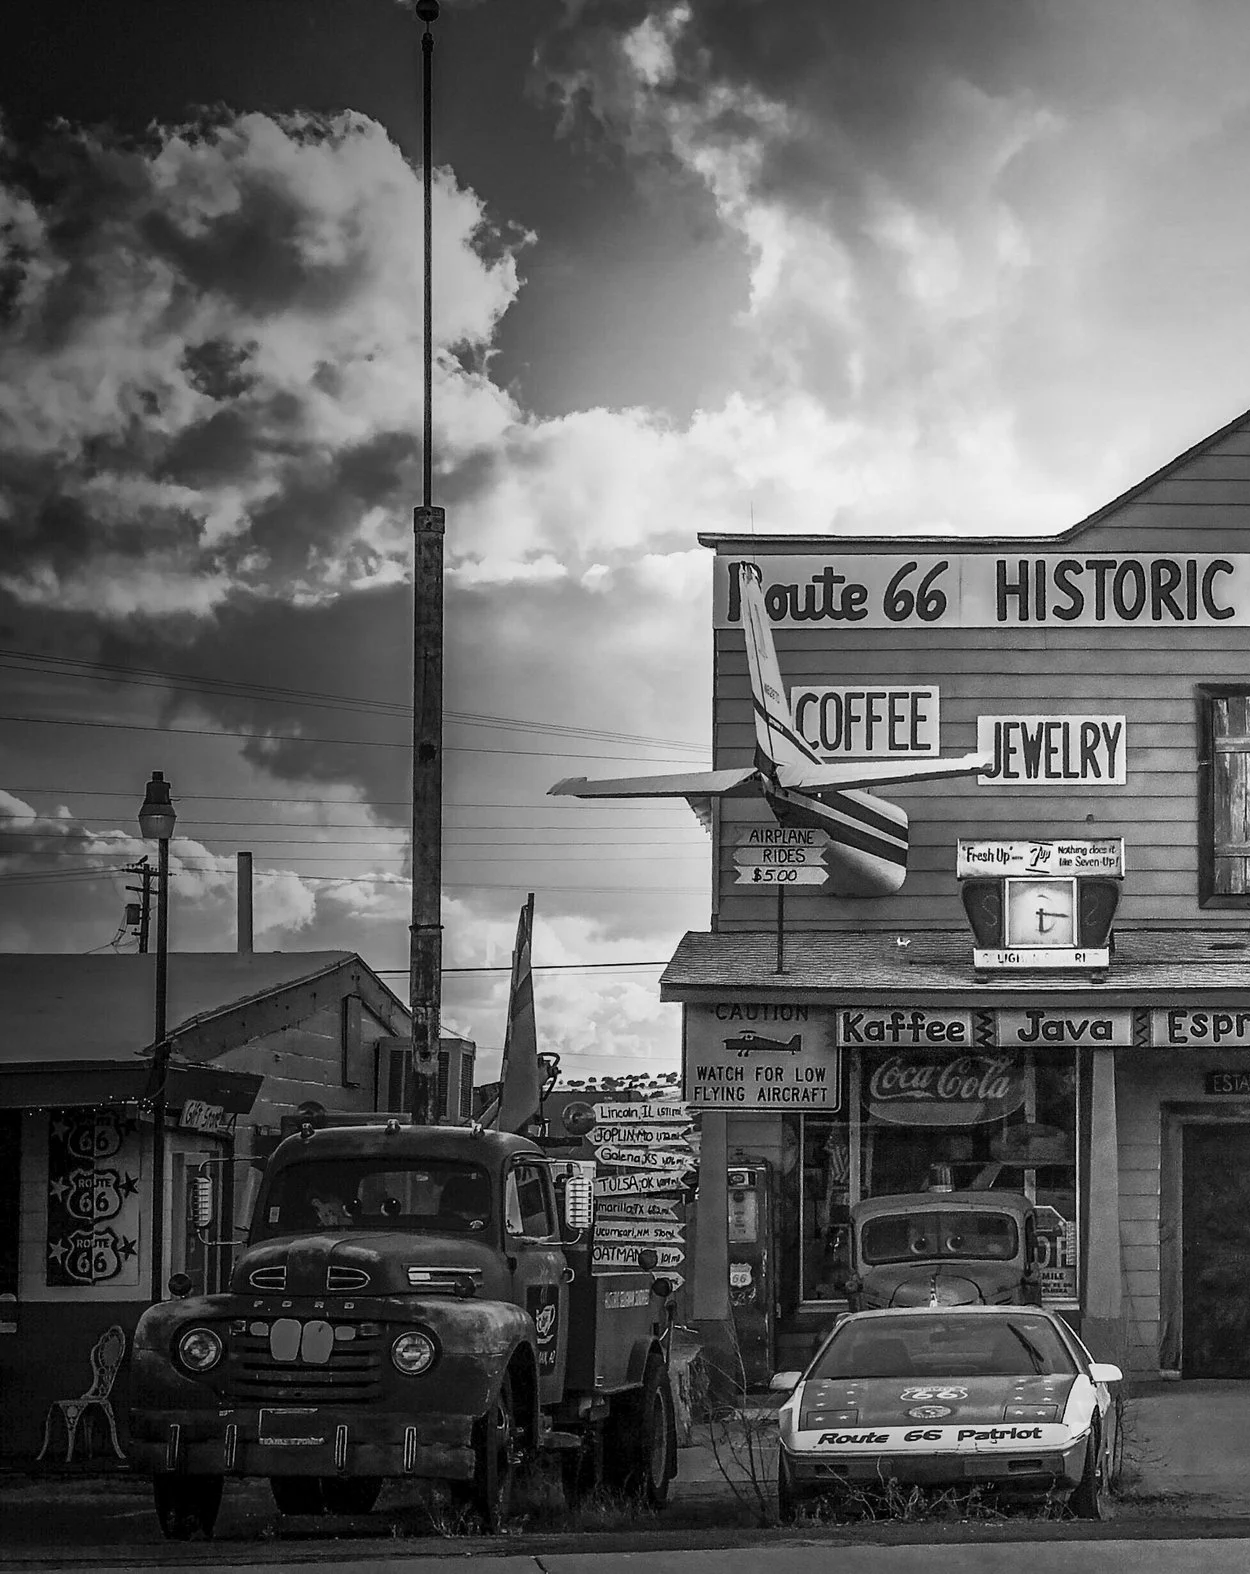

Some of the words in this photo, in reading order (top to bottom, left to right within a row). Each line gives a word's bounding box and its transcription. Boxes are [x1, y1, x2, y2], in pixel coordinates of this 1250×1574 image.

[884, 561, 950, 622] 66
[996, 559, 1235, 622] HISTORIC
[796, 691, 932, 751] COFFEE
[984, 720, 1123, 779] JEWELRY
[749, 828, 817, 845] AIRPLANE
[763, 847, 807, 864] RIDES
[1057, 844, 1088, 860] Nothing
[751, 867, 798, 883] $5.00
[716, 1003, 809, 1022] CAUTION
[843, 1010, 965, 1044] Kaffee
[1016, 1011, 1113, 1043] Java
[697, 1066, 744, 1081] WATCH
[755, 1067, 783, 1081] FOR
[796, 1067, 826, 1082] LOW
[694, 1086, 745, 1102] FLYING
[757, 1087, 827, 1103] AIRCRAFT
[641, 1105, 655, 1118] IL
[79, 1130, 109, 1151] 66
[77, 1178, 112, 1189] ROUTE
[641, 1176, 656, 1190] OK
[79, 1191, 110, 1213] 66
[598, 1202, 633, 1214] marillo,
[595, 1226, 636, 1239] ucumcari,
[75, 1239, 110, 1249] ROUTE
[76, 1251, 108, 1274] 66
[1042, 1272, 1064, 1280] MILE
[252, 1299, 356, 1310] FORD
[817, 1432, 890, 1445] Route
[903, 1429, 943, 1443] 66
